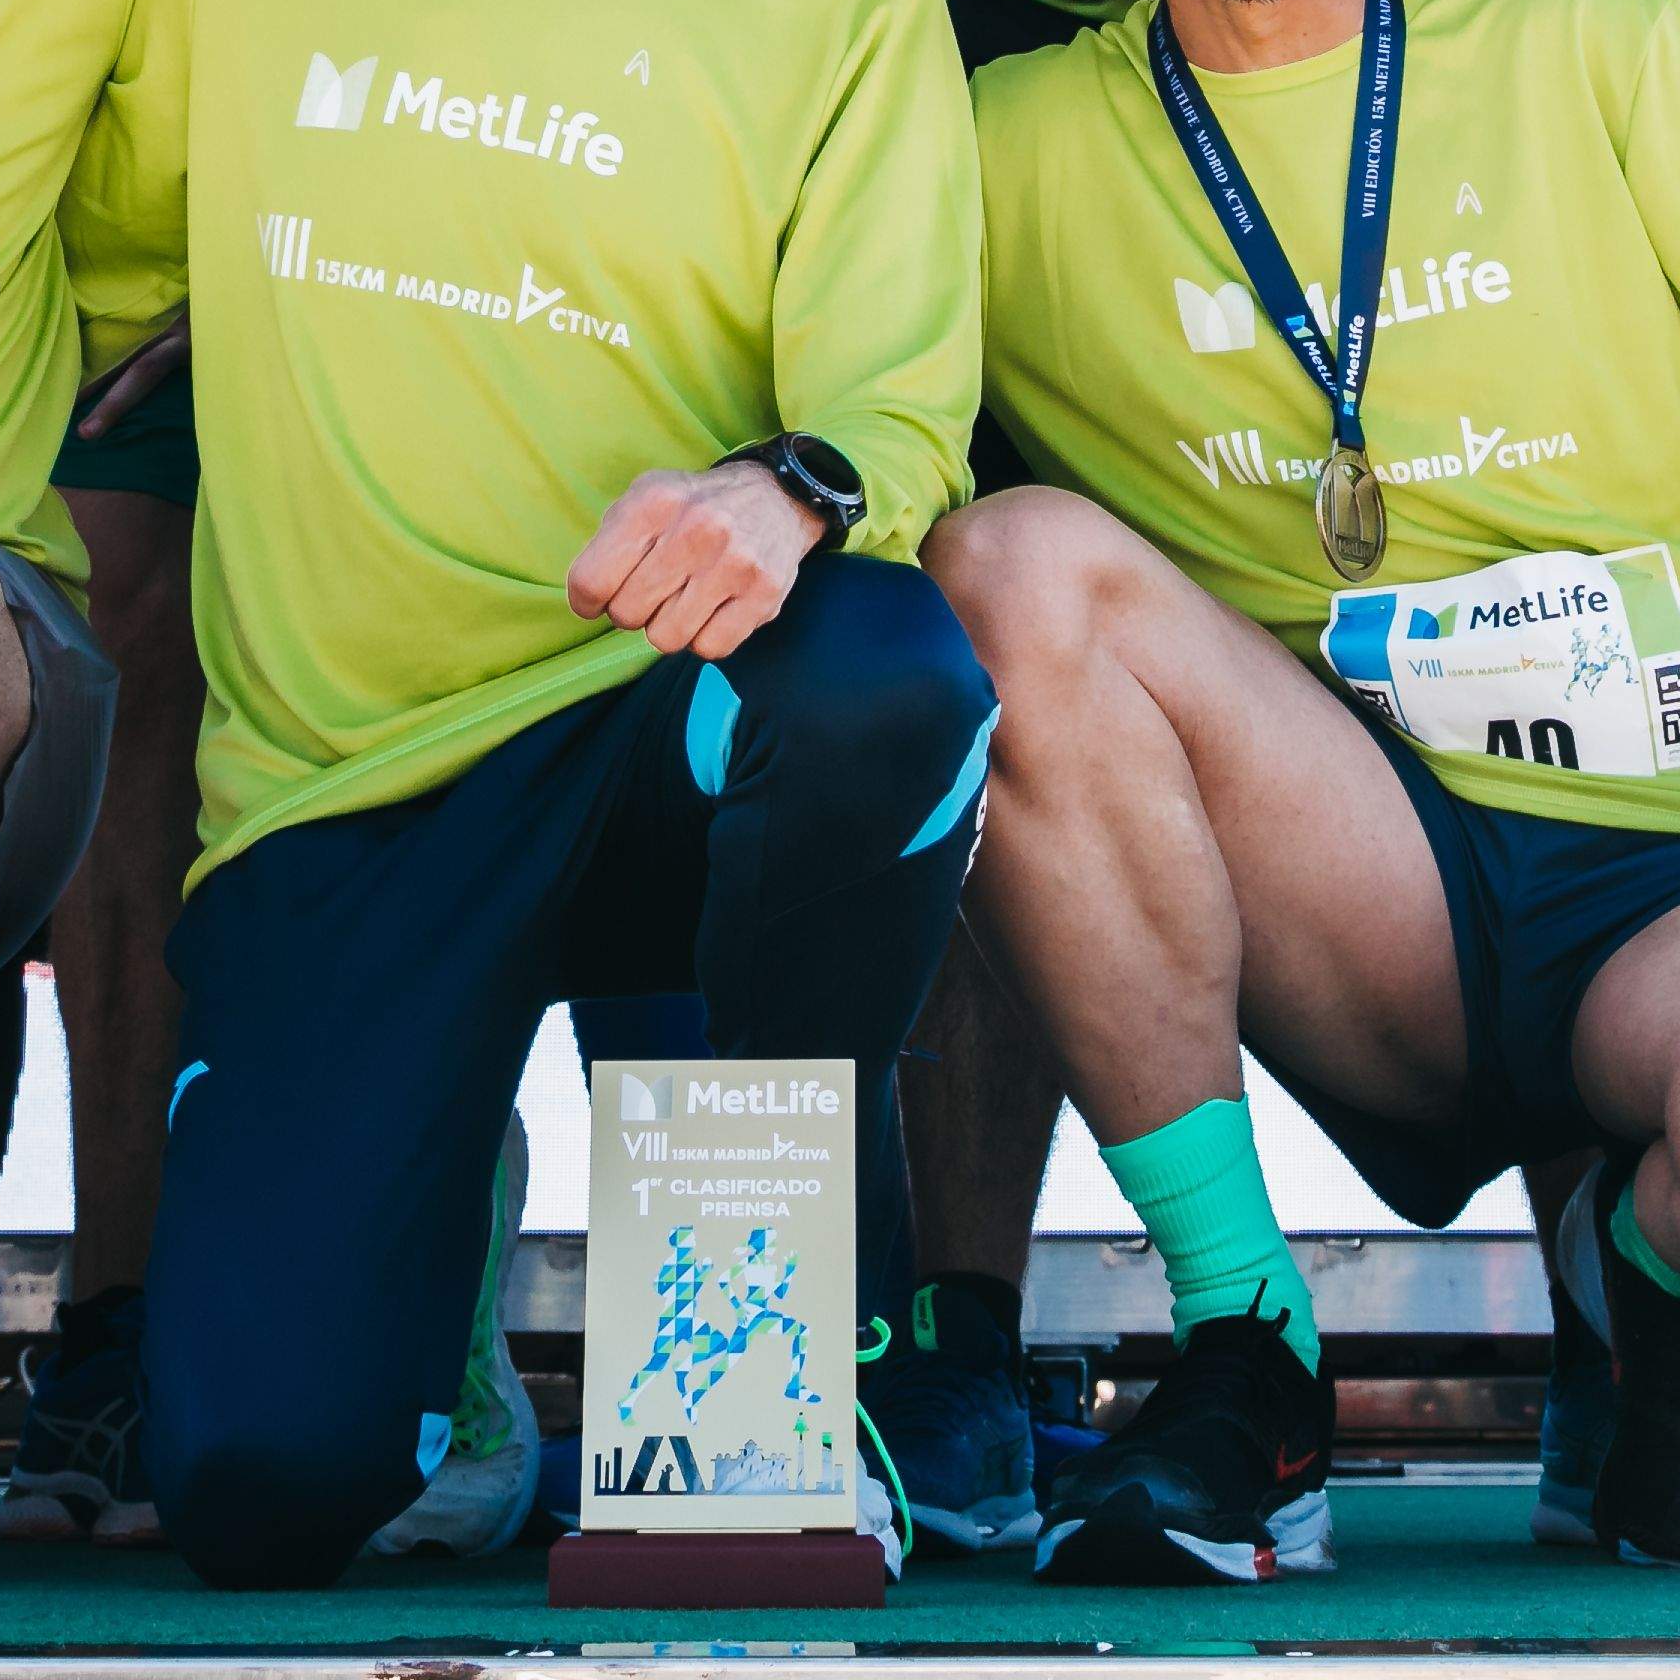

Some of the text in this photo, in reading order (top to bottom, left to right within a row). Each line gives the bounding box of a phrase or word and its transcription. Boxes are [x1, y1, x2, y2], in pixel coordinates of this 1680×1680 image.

[1376, 33, 1392, 92] METLIFE
[383, 71, 623, 177] MetLife
[1372, 94, 1386, 120] 15K
[1194, 128, 1229, 184] MADRID
[1222, 187, 1254, 235] ACTIVA
[1364, 128, 1383, 189] EDICIÓN
[1361, 193, 1376, 218] VIII
[257, 213, 313, 280] VIII
[315, 258, 385, 293] 15KM
[395, 274, 512, 321] MADRID
[1345, 315, 1366, 387] MetLife
[1177, 429, 1271, 489] VIII
[1372, 453, 1463, 485] ADRID
[1470, 584, 1608, 630] MetLife
[1408, 659, 1443, 678] VIII
[1478, 664, 1520, 675] MADRID
[686, 1080, 840, 1115] MetLife
[622, 1132, 668, 1162] VIII
[672, 1149, 709, 1161] 15KM
[714, 1148, 771, 1161] MADRID
[670, 1179, 822, 1196] CLASIFICADO
[700, 1201, 791, 1217] PRENSA
